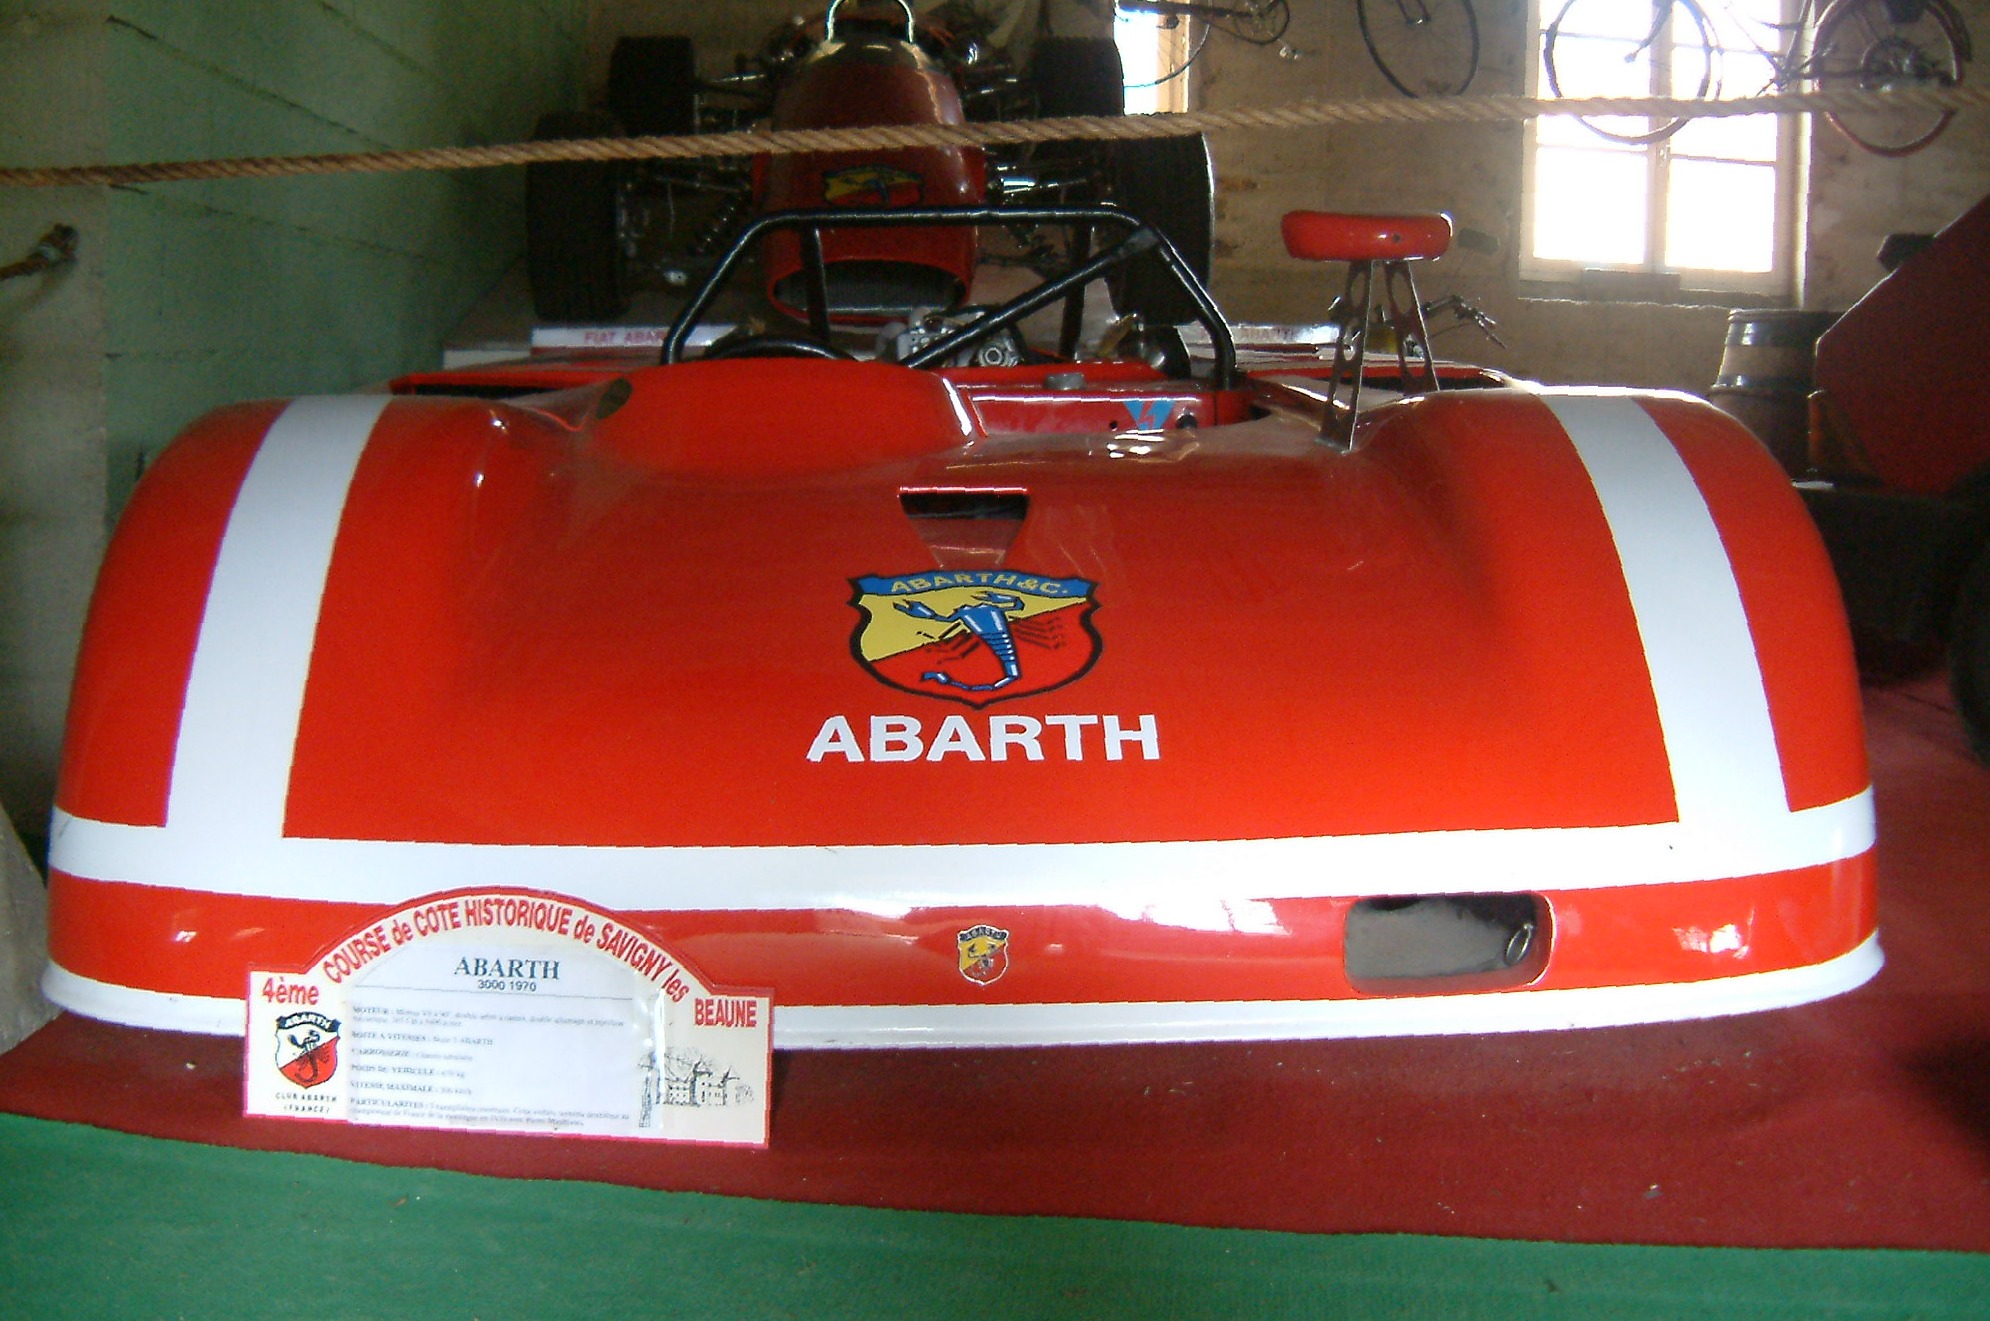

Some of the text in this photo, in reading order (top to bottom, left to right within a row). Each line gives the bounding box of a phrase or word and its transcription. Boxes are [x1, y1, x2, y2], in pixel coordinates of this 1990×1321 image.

[623, 330, 668, 343] ABAR
[806, 713, 1161, 762] ABARTH
[262, 898, 758, 1028] 4ème COURSE de COTE HISTORIQUE de SAVIGNY les BEAUNE
[454, 956, 560, 980] ABARTH
[477, 979, 537, 992] 3000 1970
